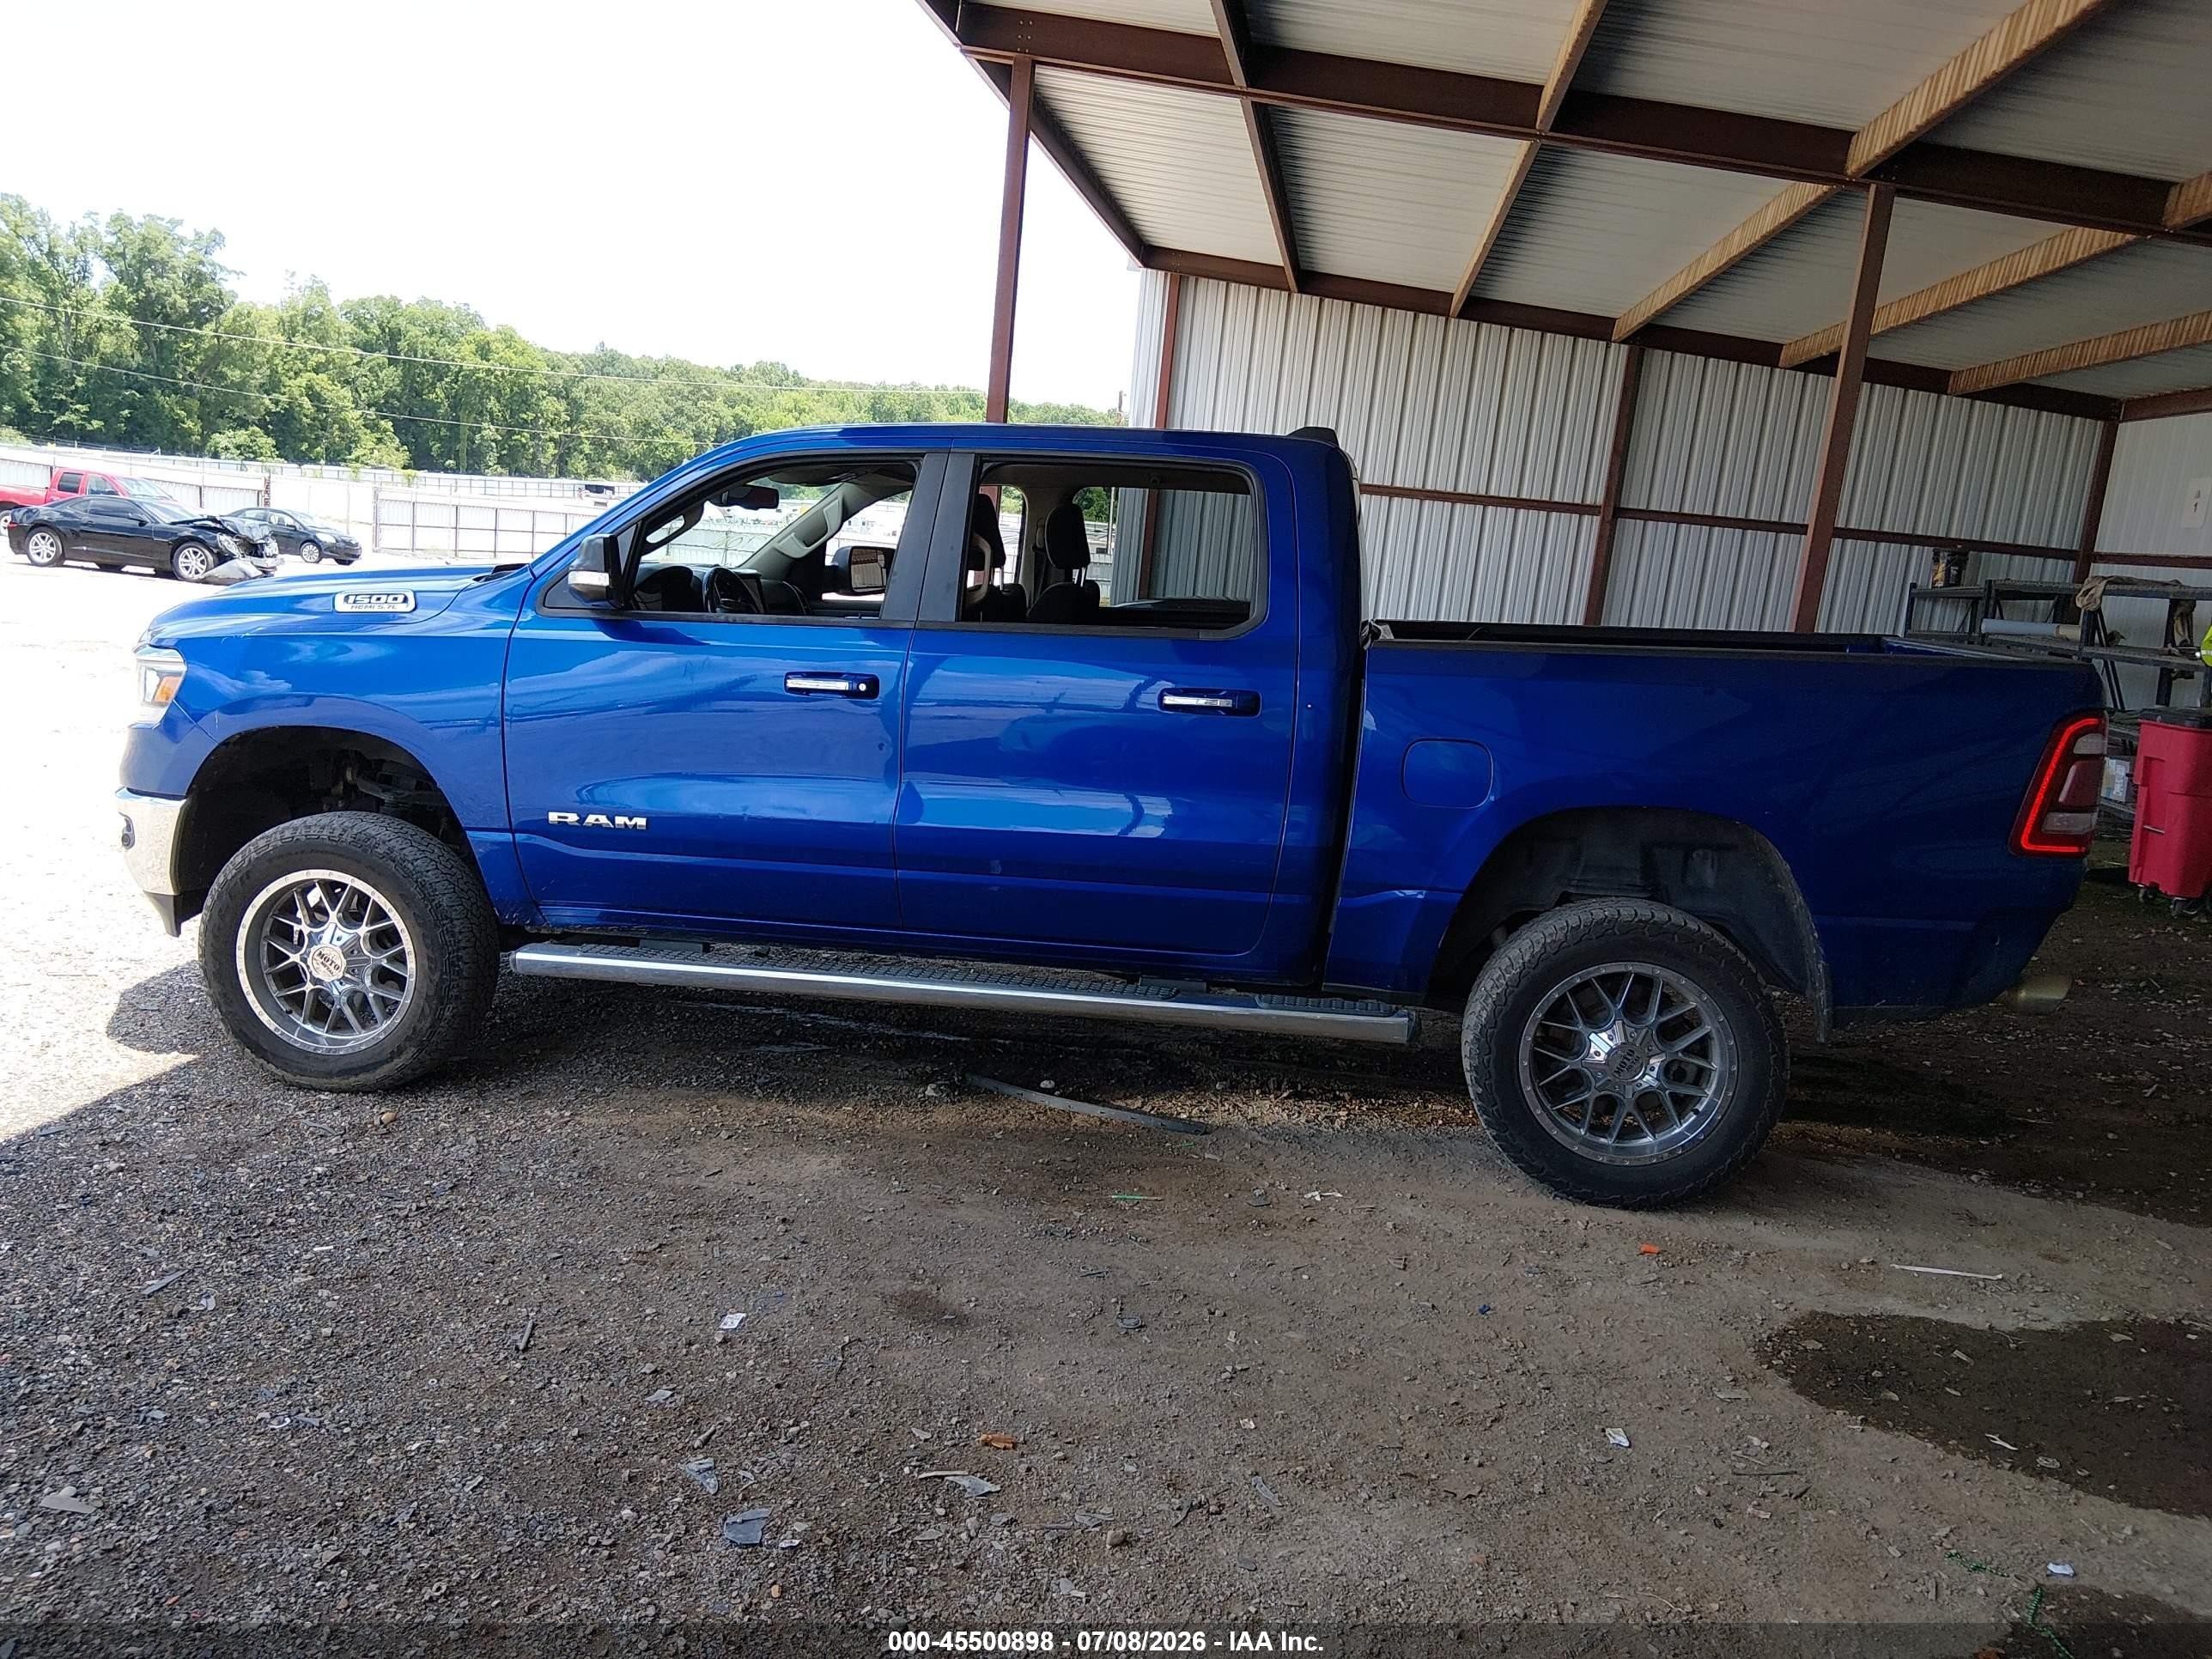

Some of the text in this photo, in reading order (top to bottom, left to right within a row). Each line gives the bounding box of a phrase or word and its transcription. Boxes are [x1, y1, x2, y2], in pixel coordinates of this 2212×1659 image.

[347, 594, 404, 605] 1500
[548, 811, 647, 830] RAM
[316, 950, 340, 971] MOTO
[1613, 1048, 1636, 1078] MOTO
